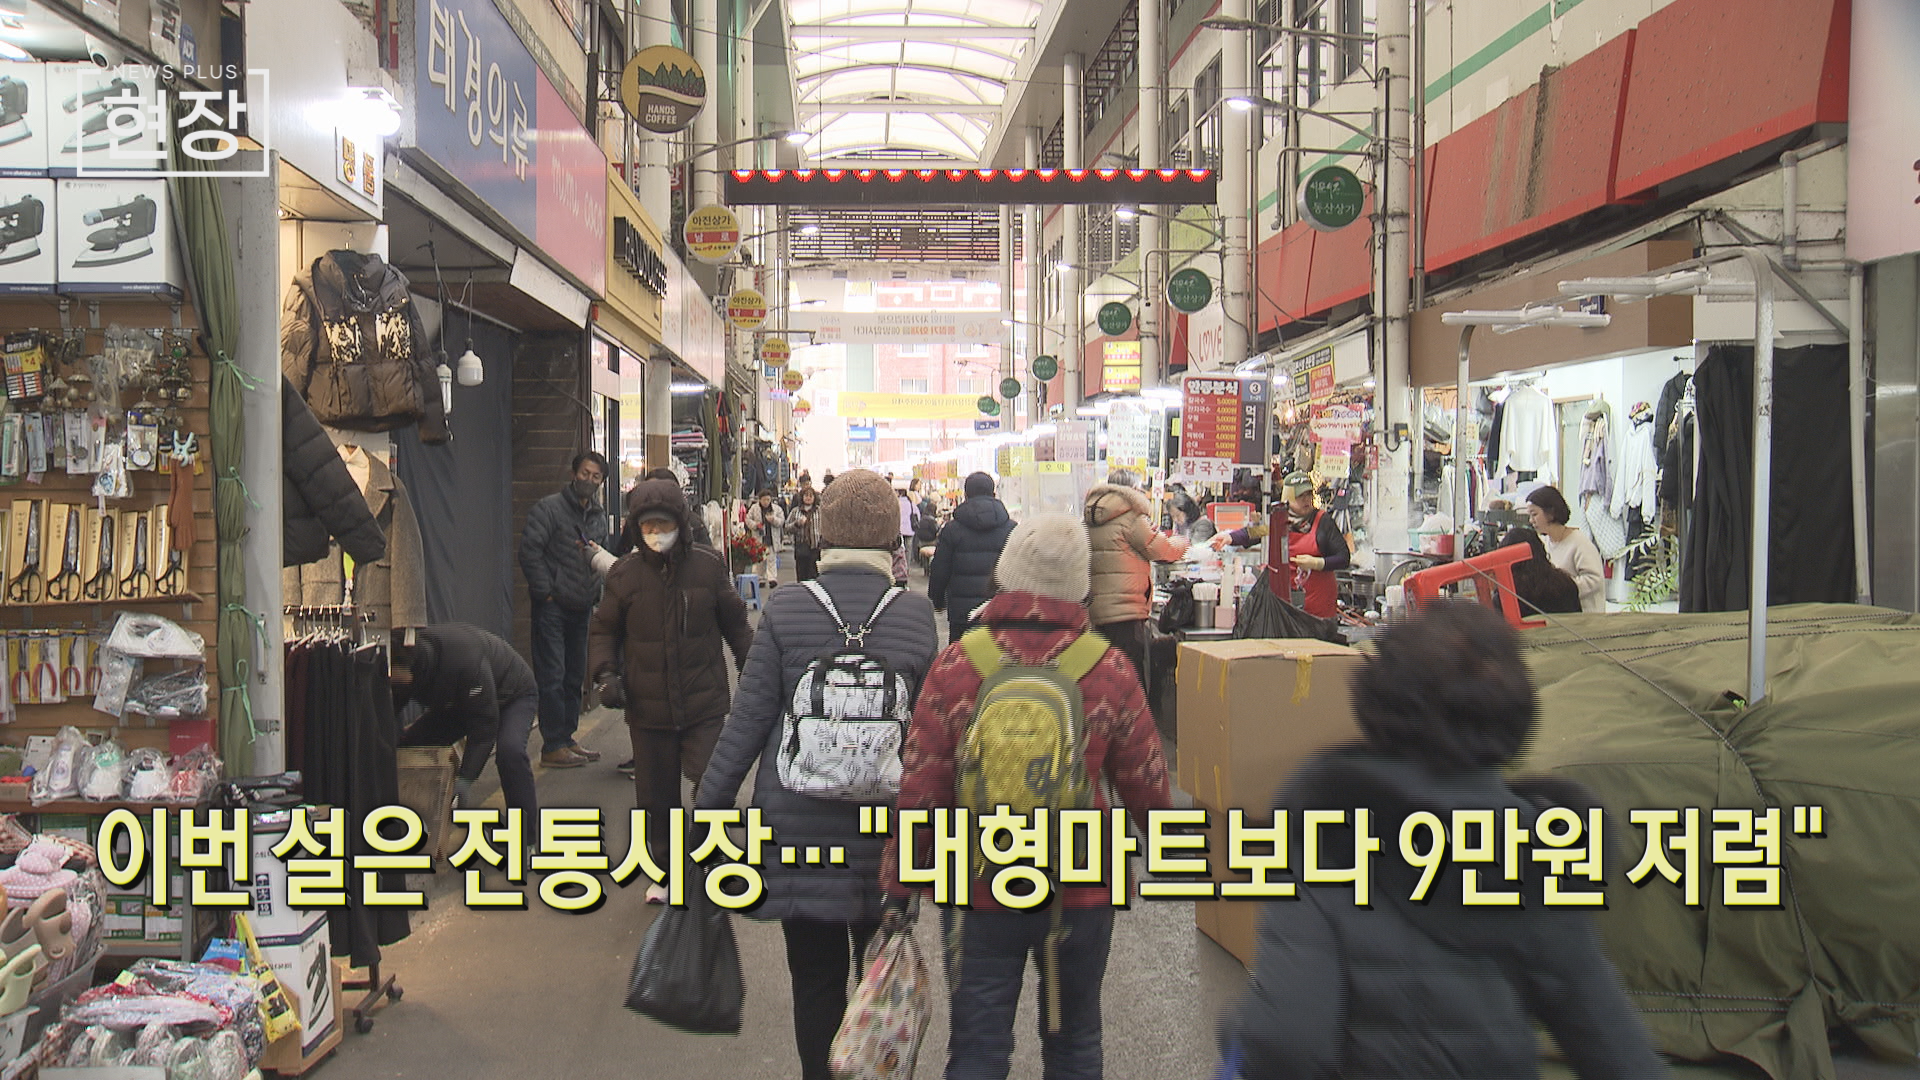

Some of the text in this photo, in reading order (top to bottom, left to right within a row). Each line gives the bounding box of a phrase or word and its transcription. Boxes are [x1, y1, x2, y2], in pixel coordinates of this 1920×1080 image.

[428, 0, 529, 182] 태경의류
[648, 104, 676, 114] HANDS
[645, 114, 677, 124] COFFEE
[1314, 202, 1355, 215] 동산상가
[692, 215, 731, 226] 아진상가
[733, 296, 761, 305] 아진상가
[1187, 380, 1239, 396] 안동분식
[1245, 405, 1256, 441] 먹거리
[1184, 460, 1230, 476] 칼국수
